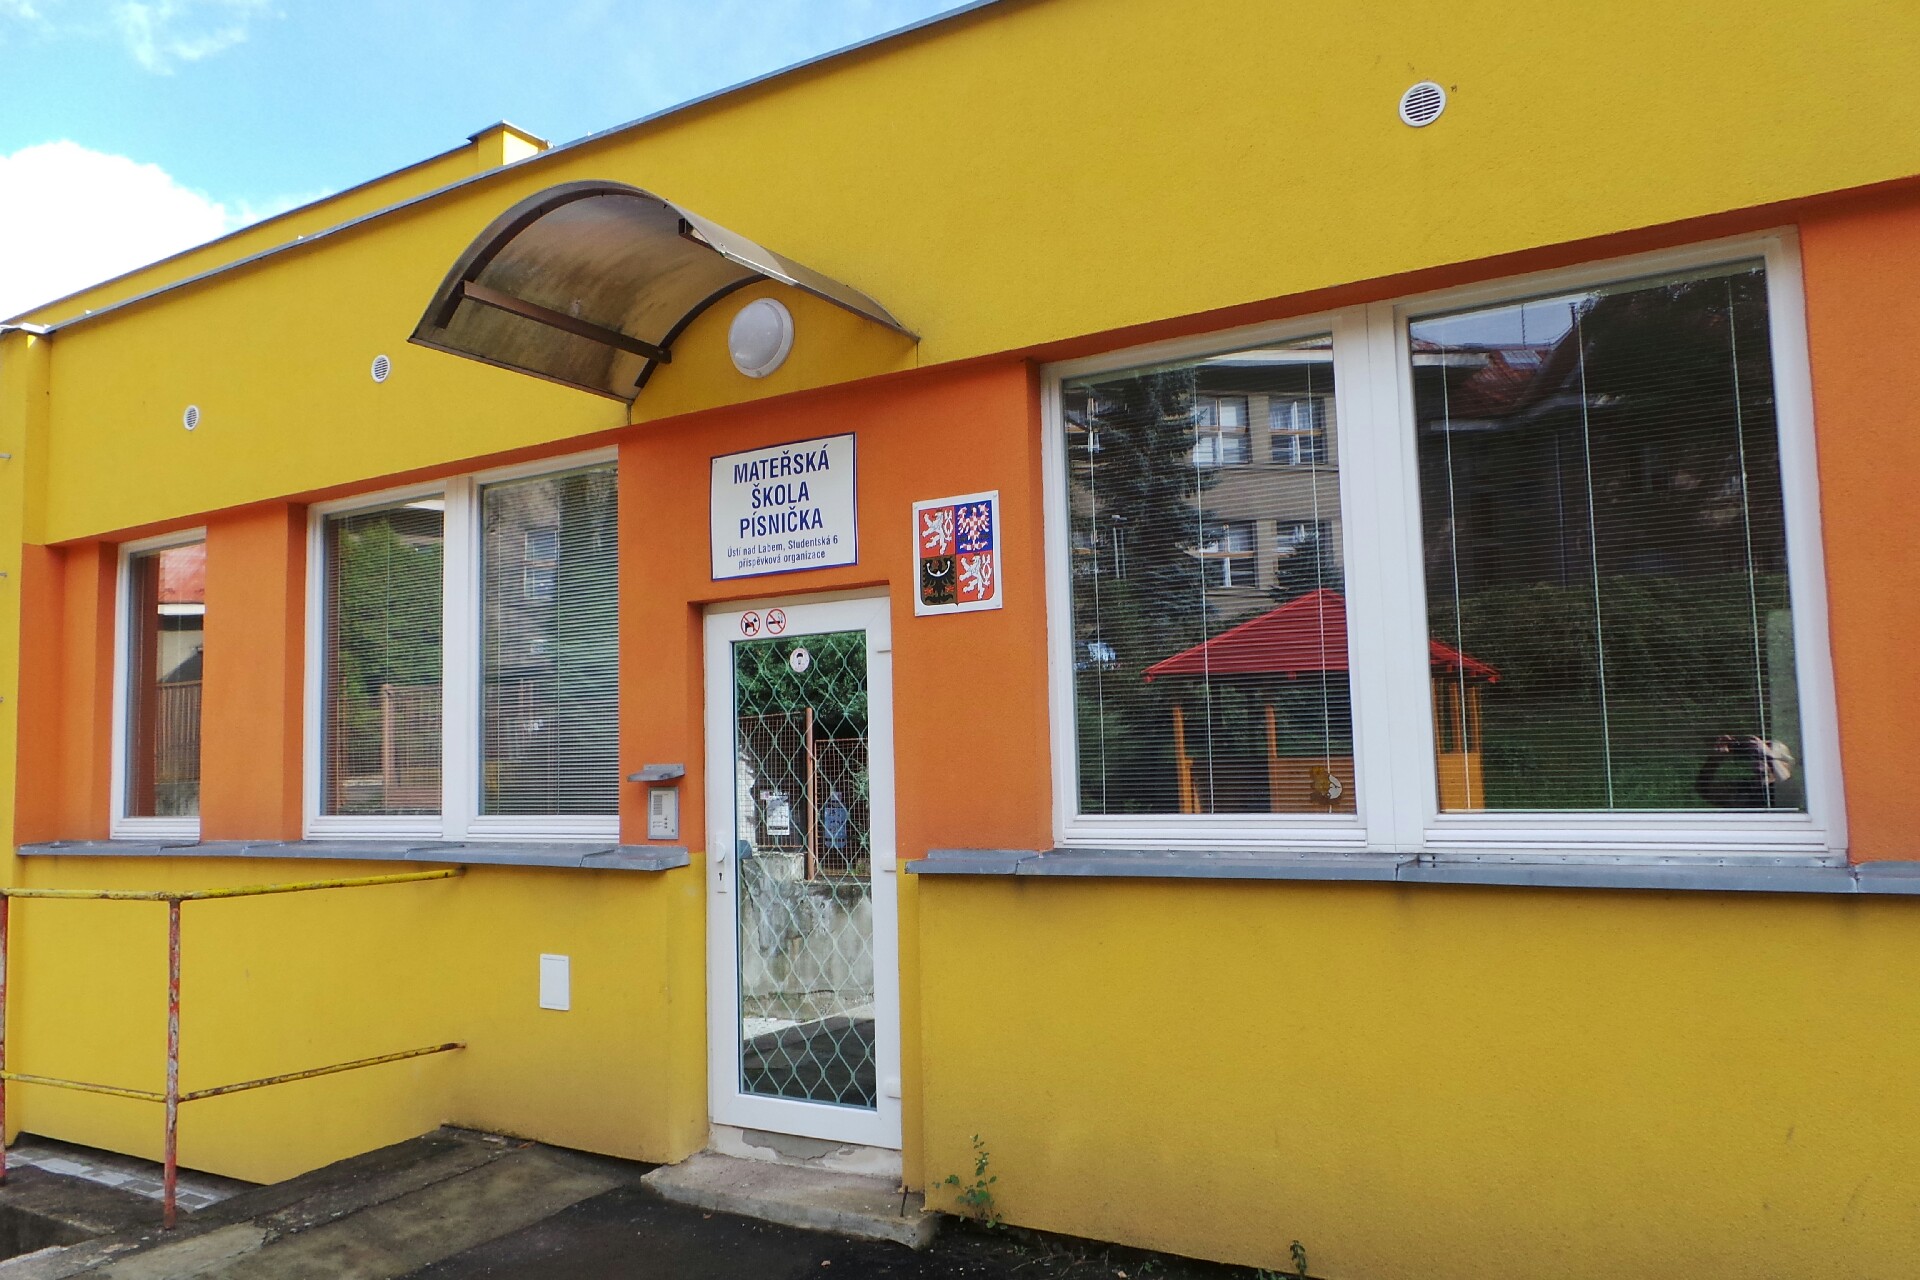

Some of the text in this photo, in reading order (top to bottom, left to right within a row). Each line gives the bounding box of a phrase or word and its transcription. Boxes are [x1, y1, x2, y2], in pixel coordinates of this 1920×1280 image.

[733, 443, 830, 484] MATEŘSKÁ
[751, 481, 810, 509] ŠKOLA
[740, 505, 823, 539] PÍSNIČKA
[727, 535, 838, 558] Ústí nad Labem, Studentská 6
[738, 550, 826, 570] příspěvková organizace
